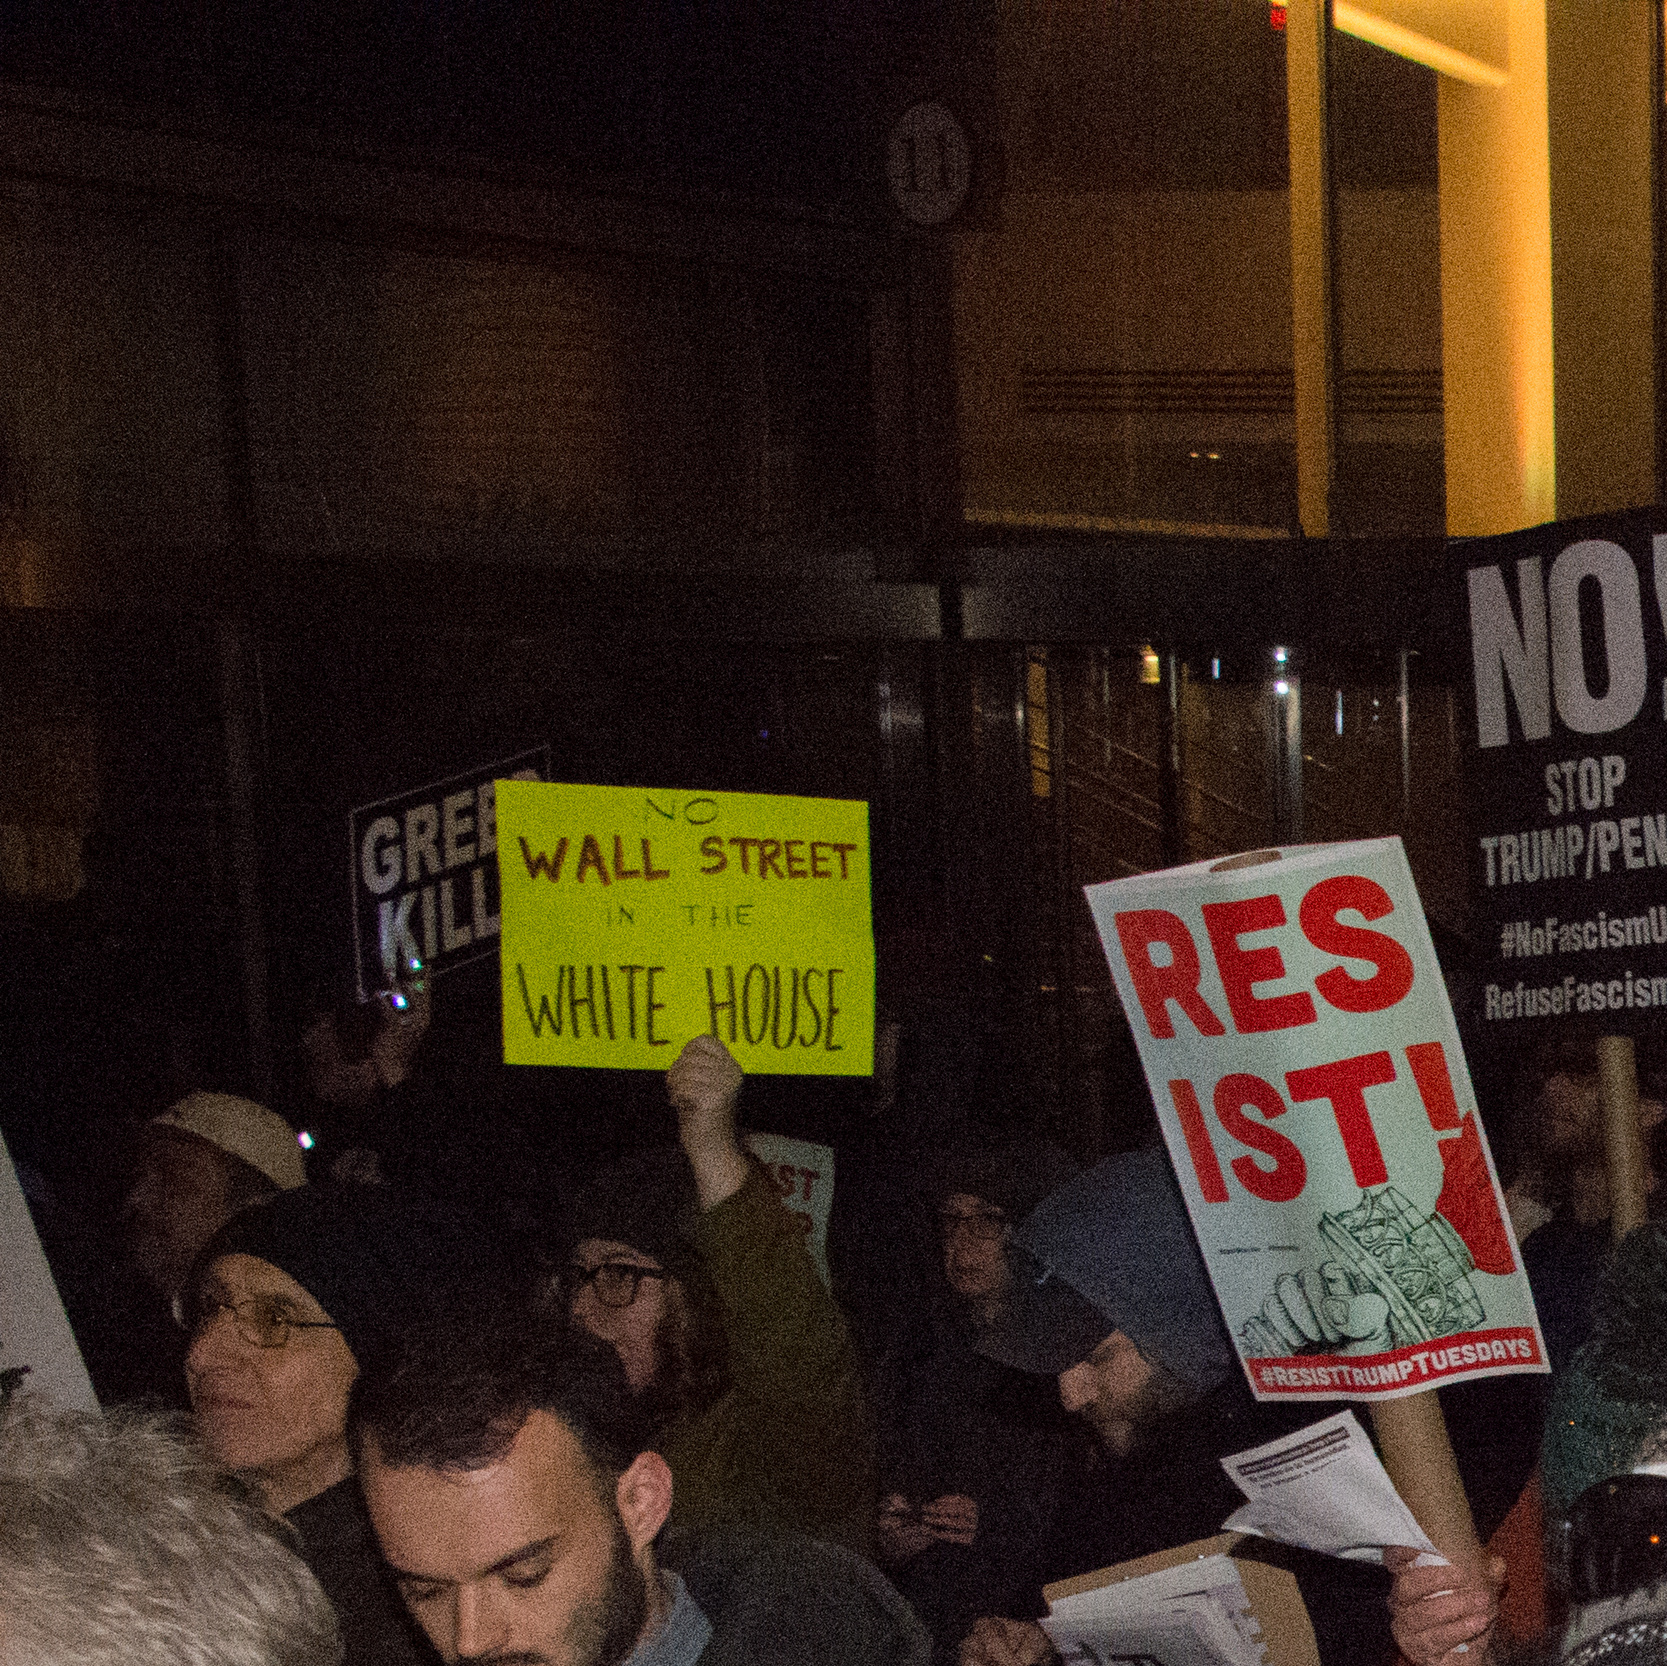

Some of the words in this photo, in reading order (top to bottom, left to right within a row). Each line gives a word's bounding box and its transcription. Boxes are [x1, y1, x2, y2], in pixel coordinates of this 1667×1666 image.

[647, 797, 719, 825] NO
[1545, 755, 1626, 816] STOP
[361, 767, 541, 896] GREE
[518, 834, 670, 886] WALL
[700, 836, 856, 880] STREET
[378, 867, 501, 982] KILL
[606, 907, 635, 925] IN
[682, 904, 754, 927] THE
[1114, 875, 1414, 1039] RES
[517, 963, 670, 1046] WHITE
[706, 963, 844, 1050] HOUSE
[1168, 1041, 1462, 1203] IST!
[1261, 1338, 1531, 1387] #RESISTTRUMPTUESDAYS
